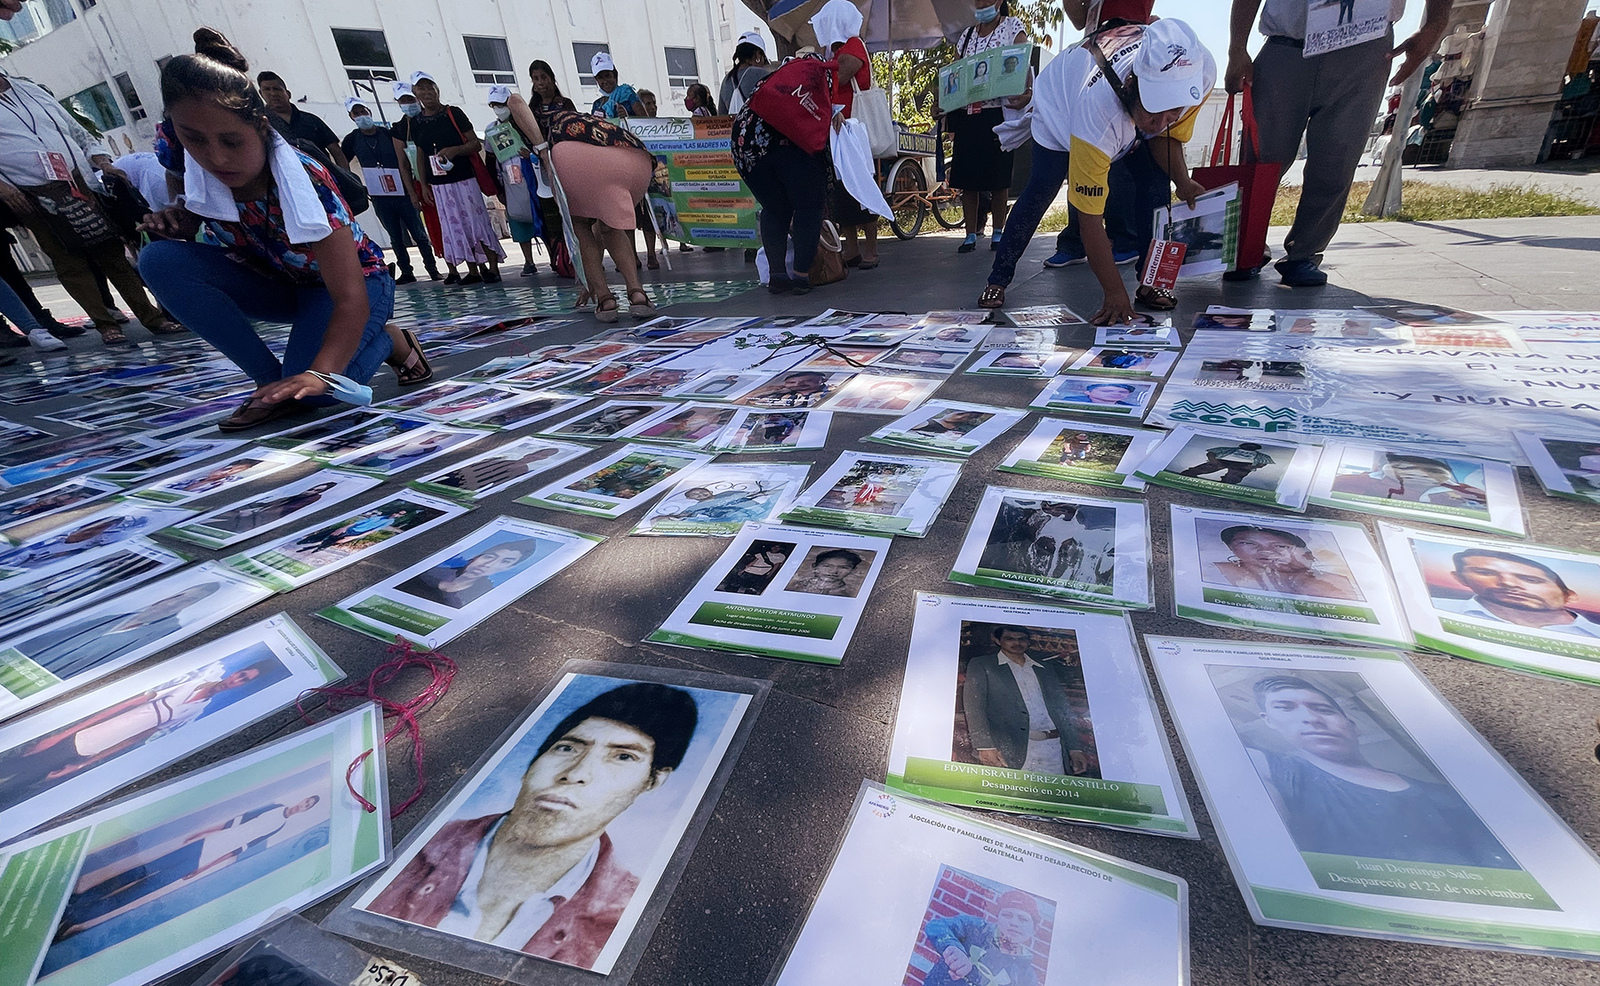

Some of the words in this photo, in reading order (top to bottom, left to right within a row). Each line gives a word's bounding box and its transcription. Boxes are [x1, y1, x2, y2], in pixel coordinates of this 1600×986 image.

[1146, 242, 1164, 284] Guatemala
[1354, 348, 1548, 359] CARAVANA
[1466, 362, 1497, 370] El
[1432, 394, 1600, 411] NUNCA
[1002, 572, 1044, 583] MARLON
[778, 610, 816, 619] RAYMUNDO
[1317, 612, 1339, 620] julio
[1341, 614, 1367, 622] 2009
[1443, 618, 1510, 637] FLORENCIO
[1512, 633, 1533, 641] DEL
[1477, 632, 1540, 648] Desapareció
[944, 764, 978, 775] EDVIN
[981, 768, 1020, 780] ISRAEL
[1024, 772, 1058, 786] PÉREZ
[1061, 778, 1120, 792] CASTILLO
[982, 779, 1038, 794] Desapareció
[1041, 788, 1053, 796] en
[1056, 788, 1080, 799] 2014
[908, 813, 946, 830] ASOCIACIÓN
[947, 825, 956, 833] DE
[956, 828, 994, 845] FAMILIARES
[1004, 843, 1043, 860] MIGRANTES
[1044, 856, 1101, 878] DESAPARECIDOS
[1102, 874, 1112, 882] DE
[983, 846, 1024, 863] GUATEMALA
[1355, 860, 1382, 872] Juan
[1386, 863, 1444, 880] Domingo
[1448, 868, 1482, 881] Sales
[1328, 872, 1406, 889] Desapareció
[1409, 880, 1422, 890] el
[1424, 882, 1440, 892] 23
[1444, 884, 1460, 894] de
[1462, 886, 1534, 900] noviembre
